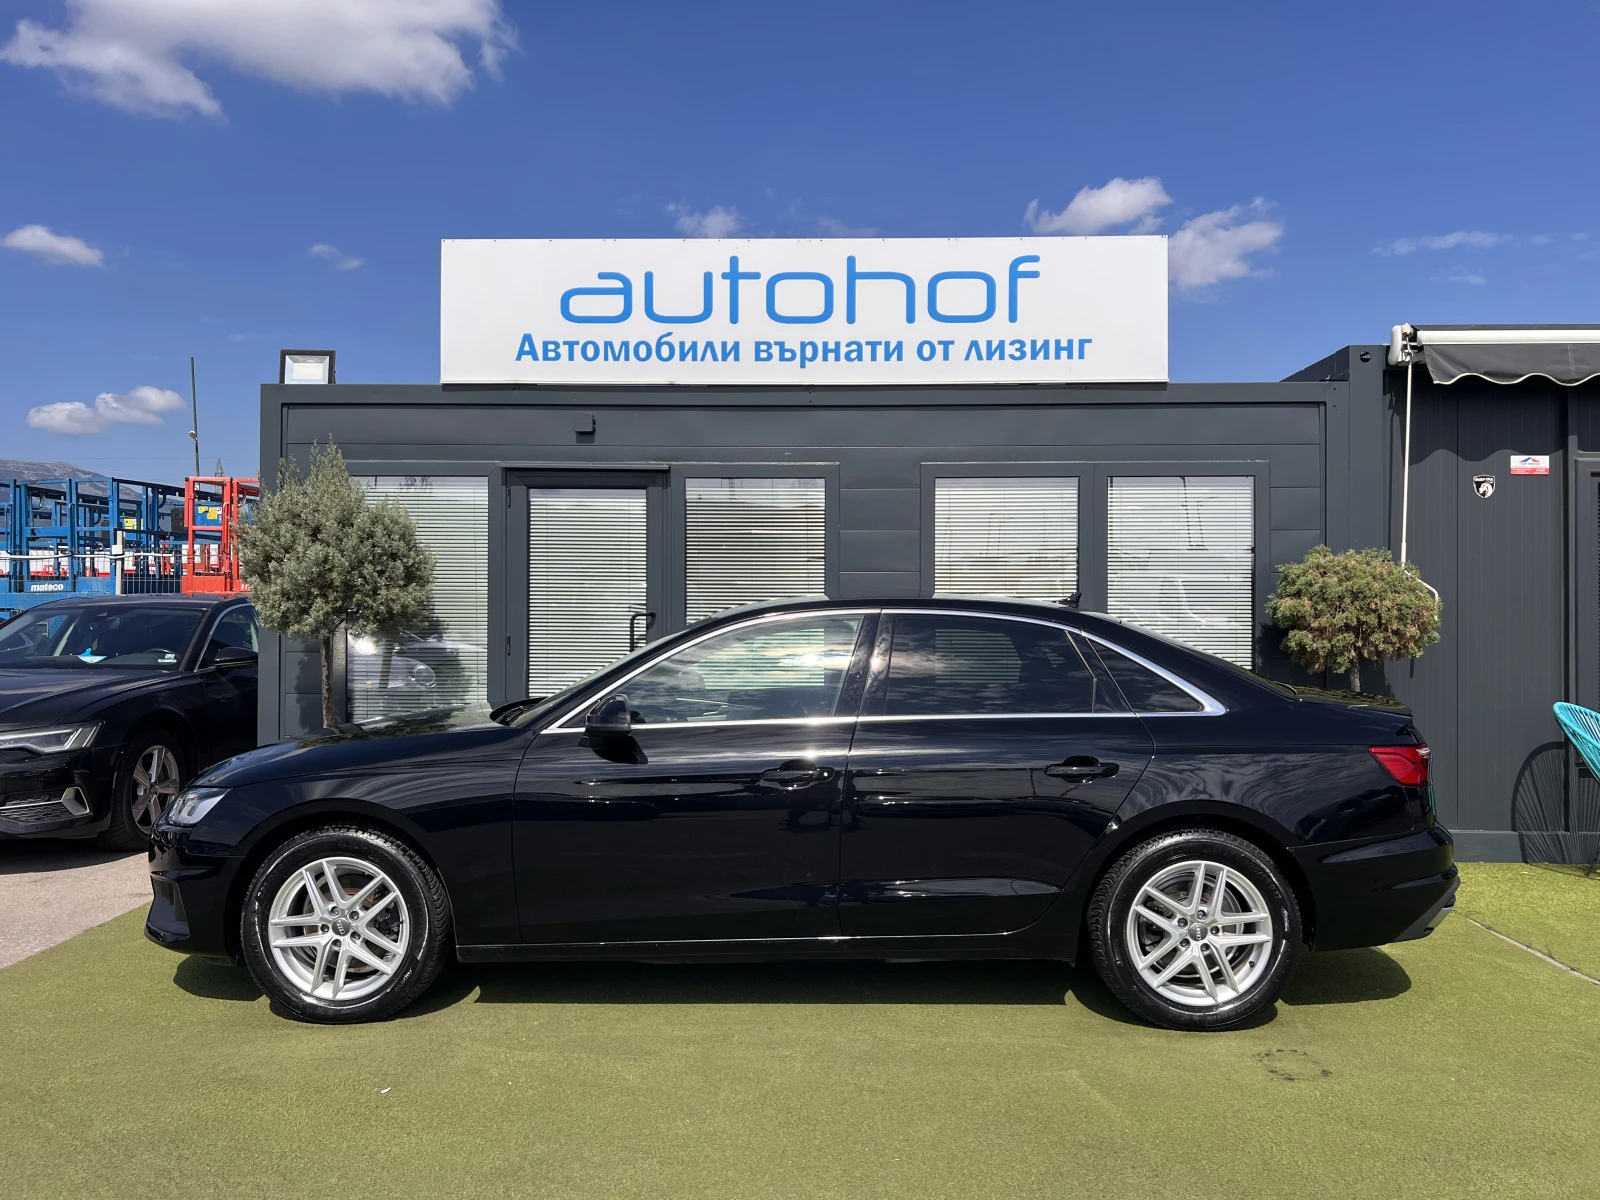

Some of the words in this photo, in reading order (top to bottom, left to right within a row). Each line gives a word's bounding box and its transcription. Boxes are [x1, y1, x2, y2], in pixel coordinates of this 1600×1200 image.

[560, 255, 1041, 325] autohof
[515, 332, 741, 363] Автомобили
[753, 339, 904, 369] върнати
[915, 339, 956, 363] от
[964, 337, 1093, 362] лизинг
[30, 583, 64, 592] mateco
